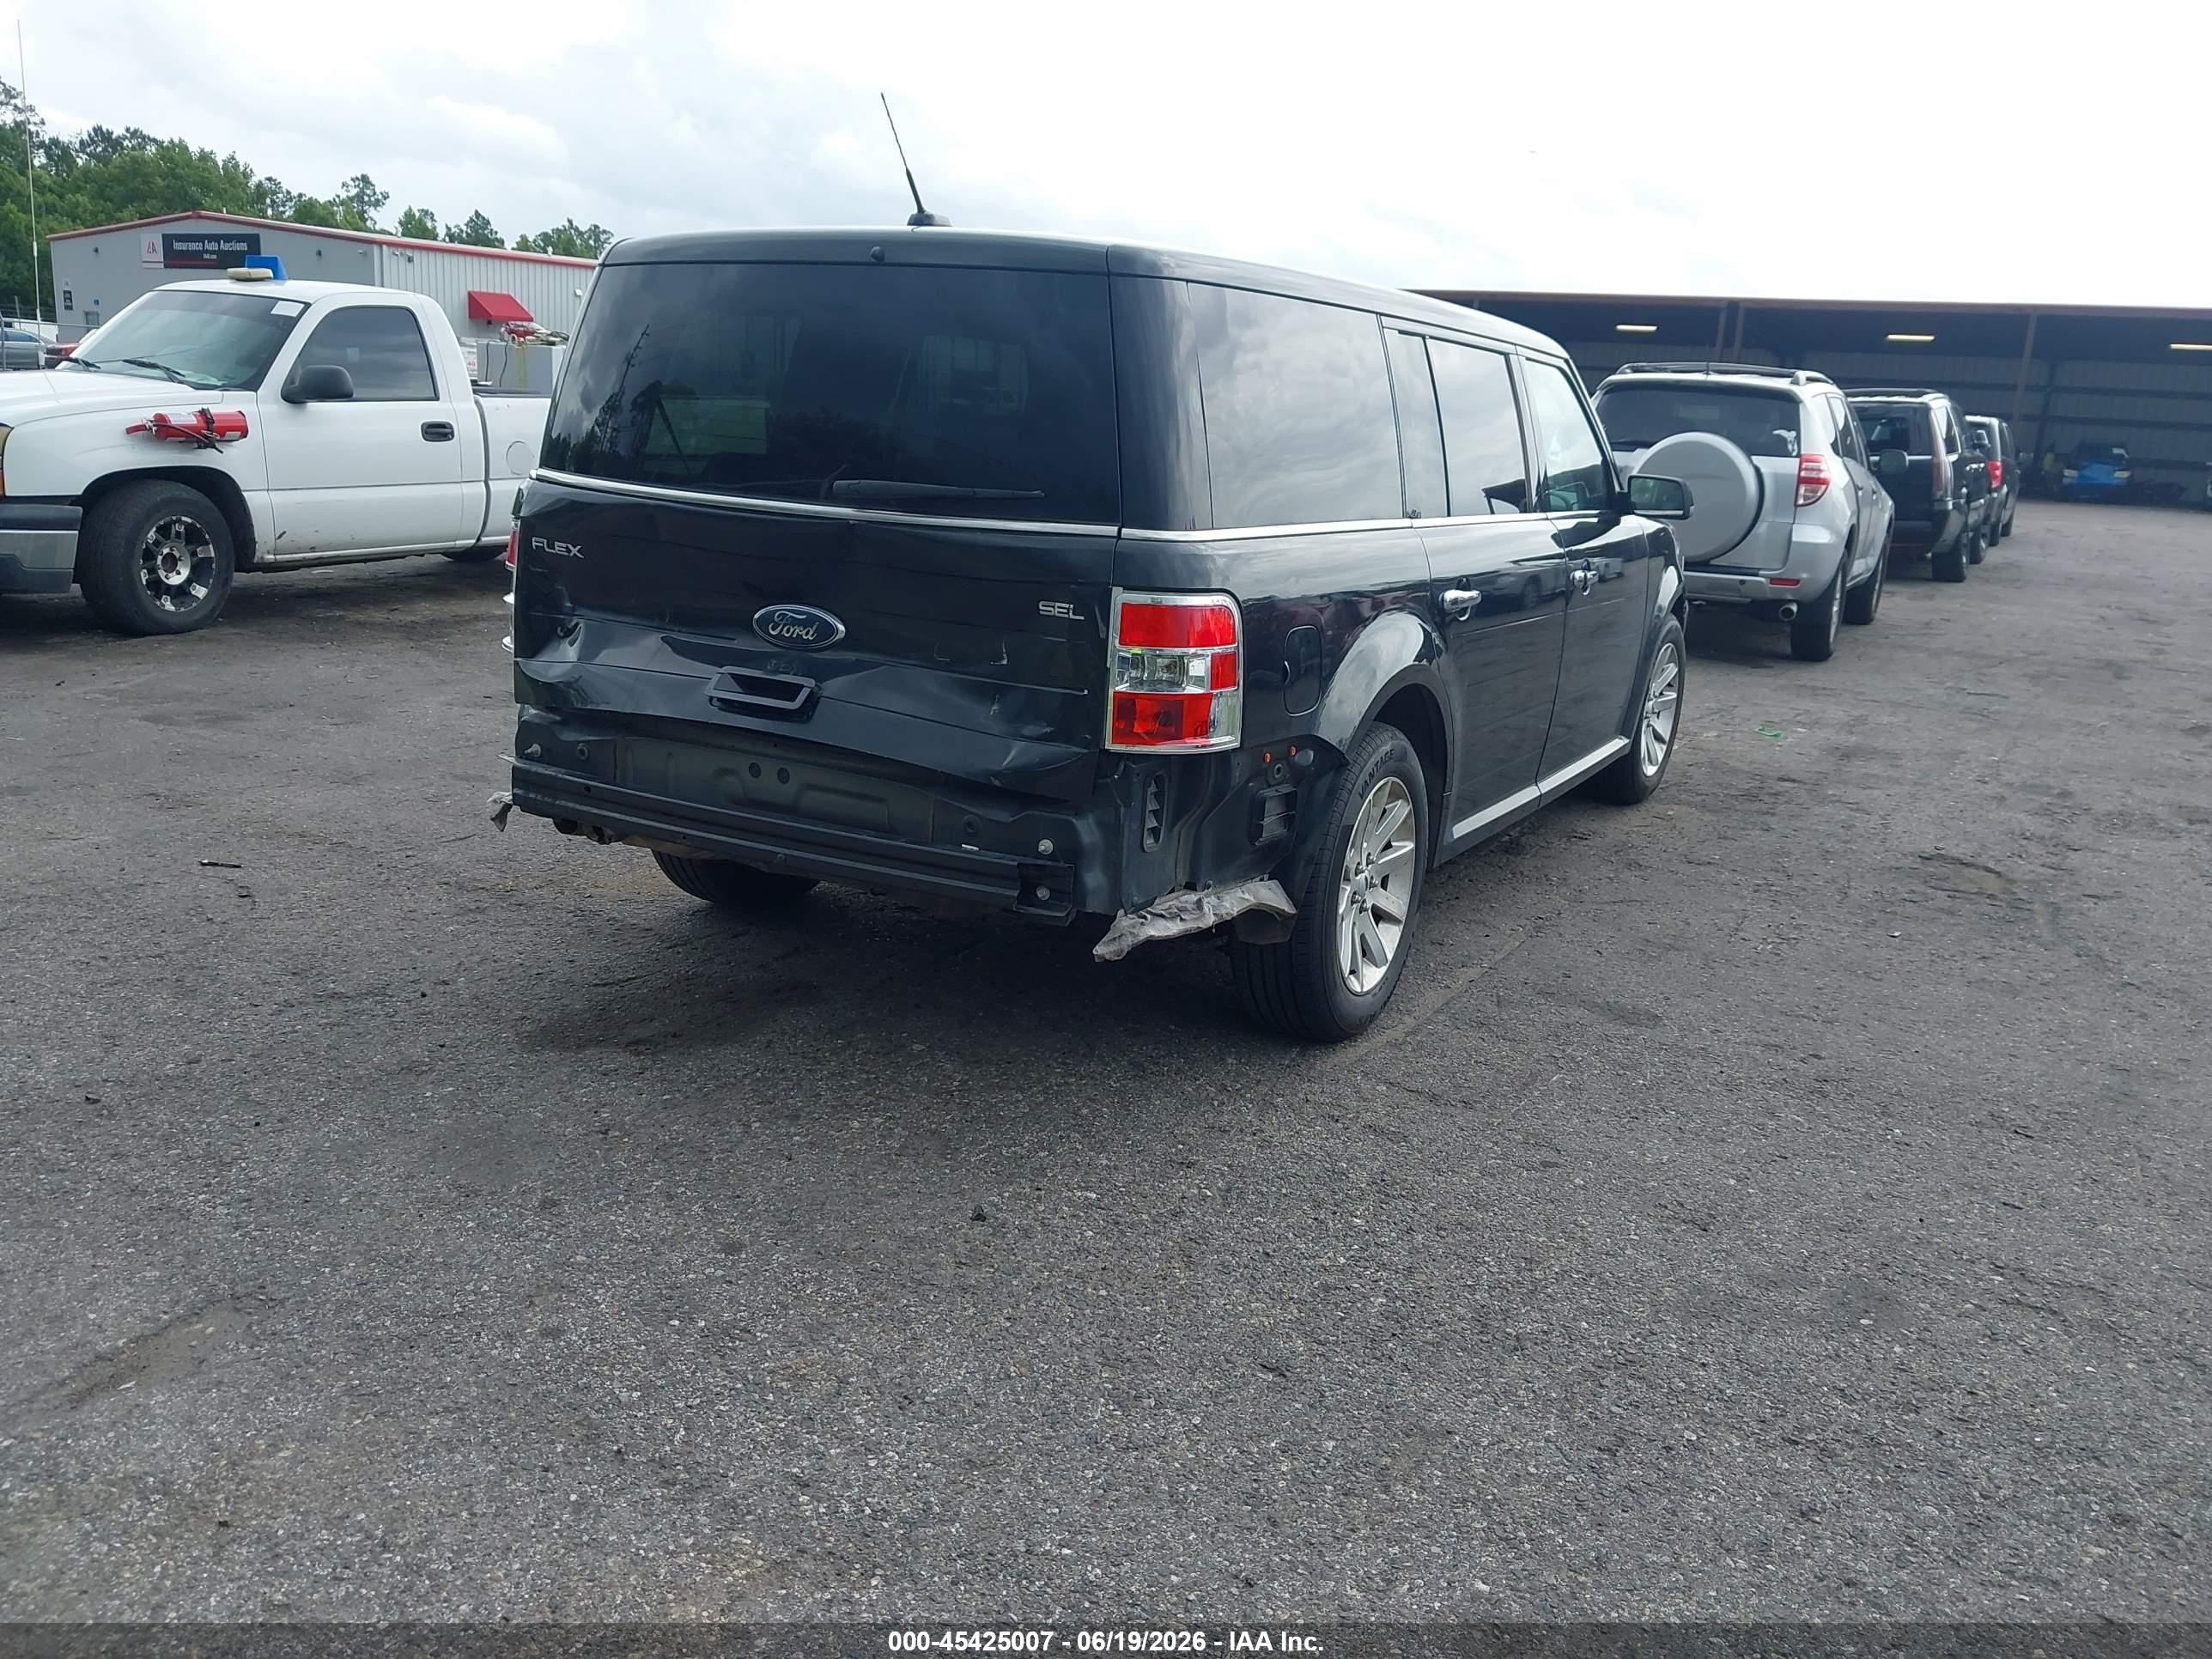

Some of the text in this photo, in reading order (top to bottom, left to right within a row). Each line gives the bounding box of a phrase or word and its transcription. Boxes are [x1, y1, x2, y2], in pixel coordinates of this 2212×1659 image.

[173, 240, 248, 252] Insurance Auto Auctions
[532, 536, 585, 558] FLEX
[1038, 600, 1085, 620] SEL
[769, 611, 820, 640] Ford
